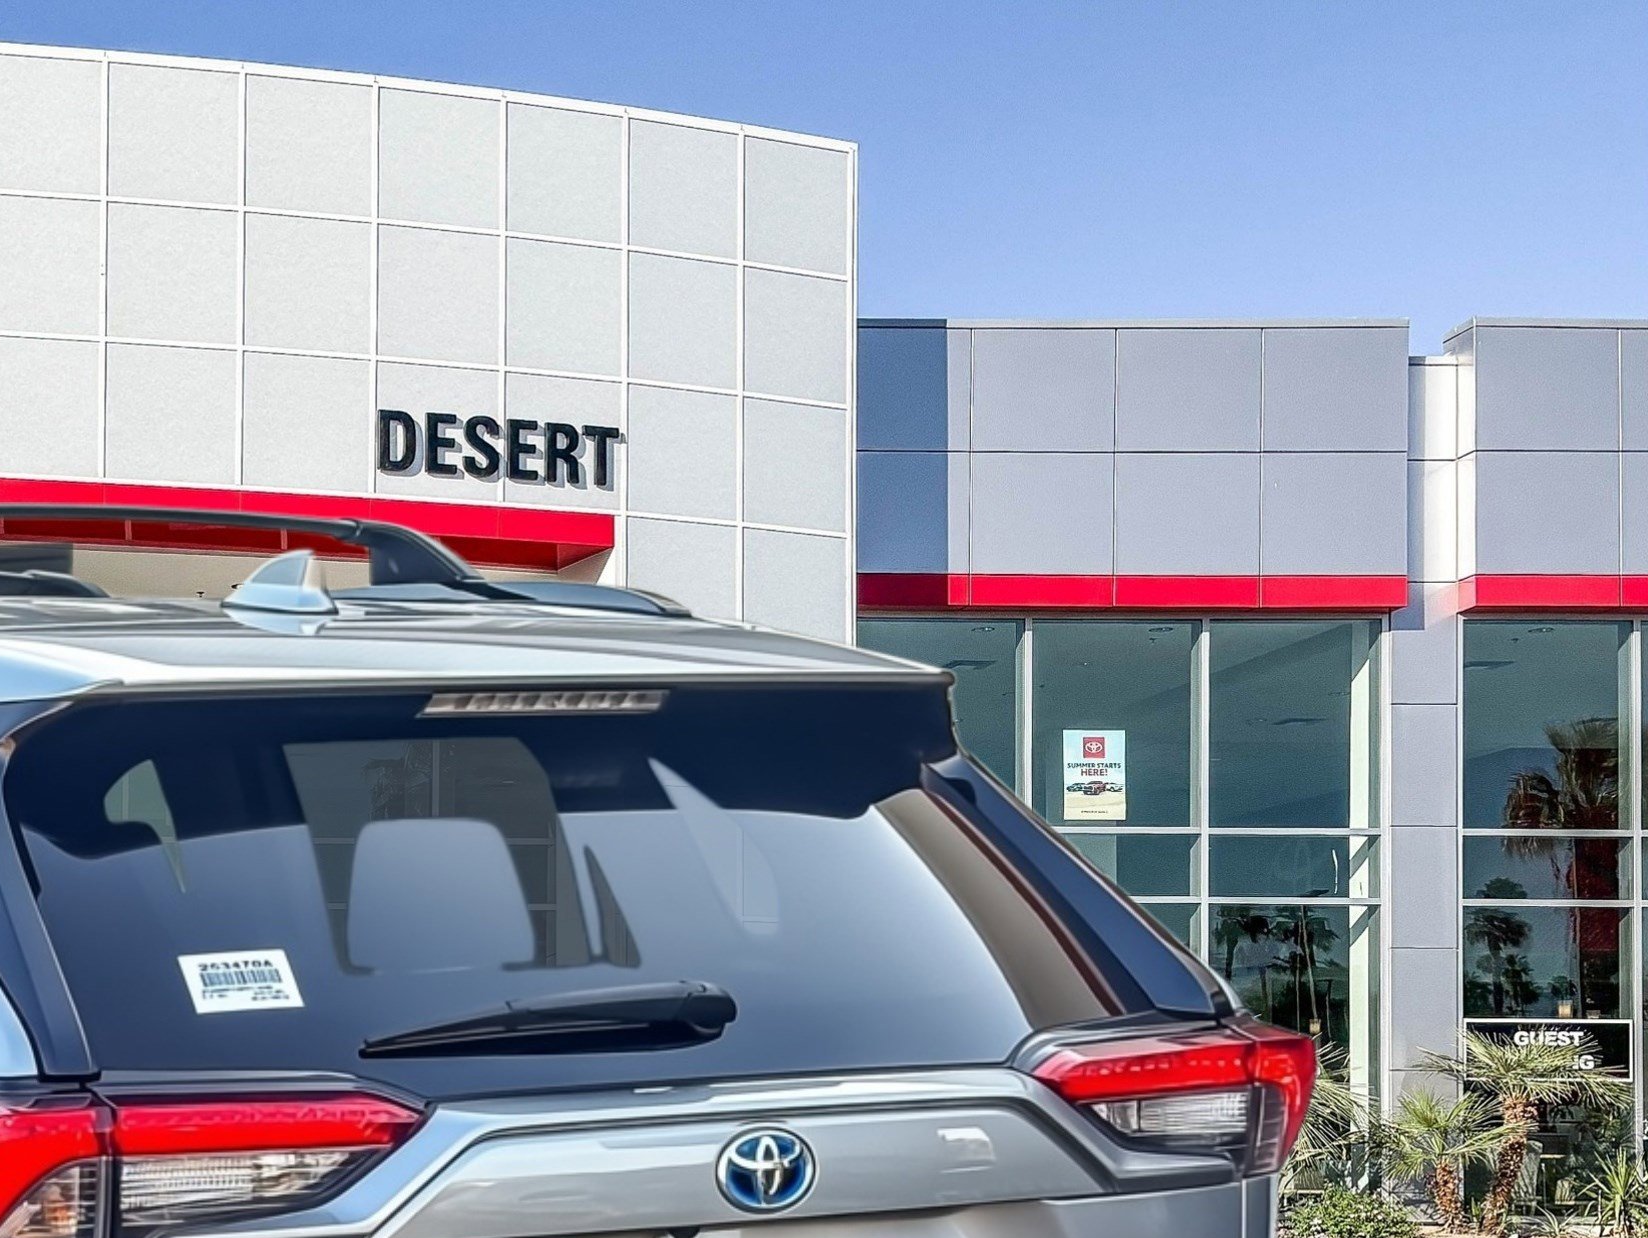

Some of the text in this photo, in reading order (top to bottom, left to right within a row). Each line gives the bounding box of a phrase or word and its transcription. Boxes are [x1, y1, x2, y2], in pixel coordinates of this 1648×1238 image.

[377, 408, 620, 487] DESERT
[1080, 768, 1108, 776] HERE!
[1513, 1030, 1585, 1047] GUEST
